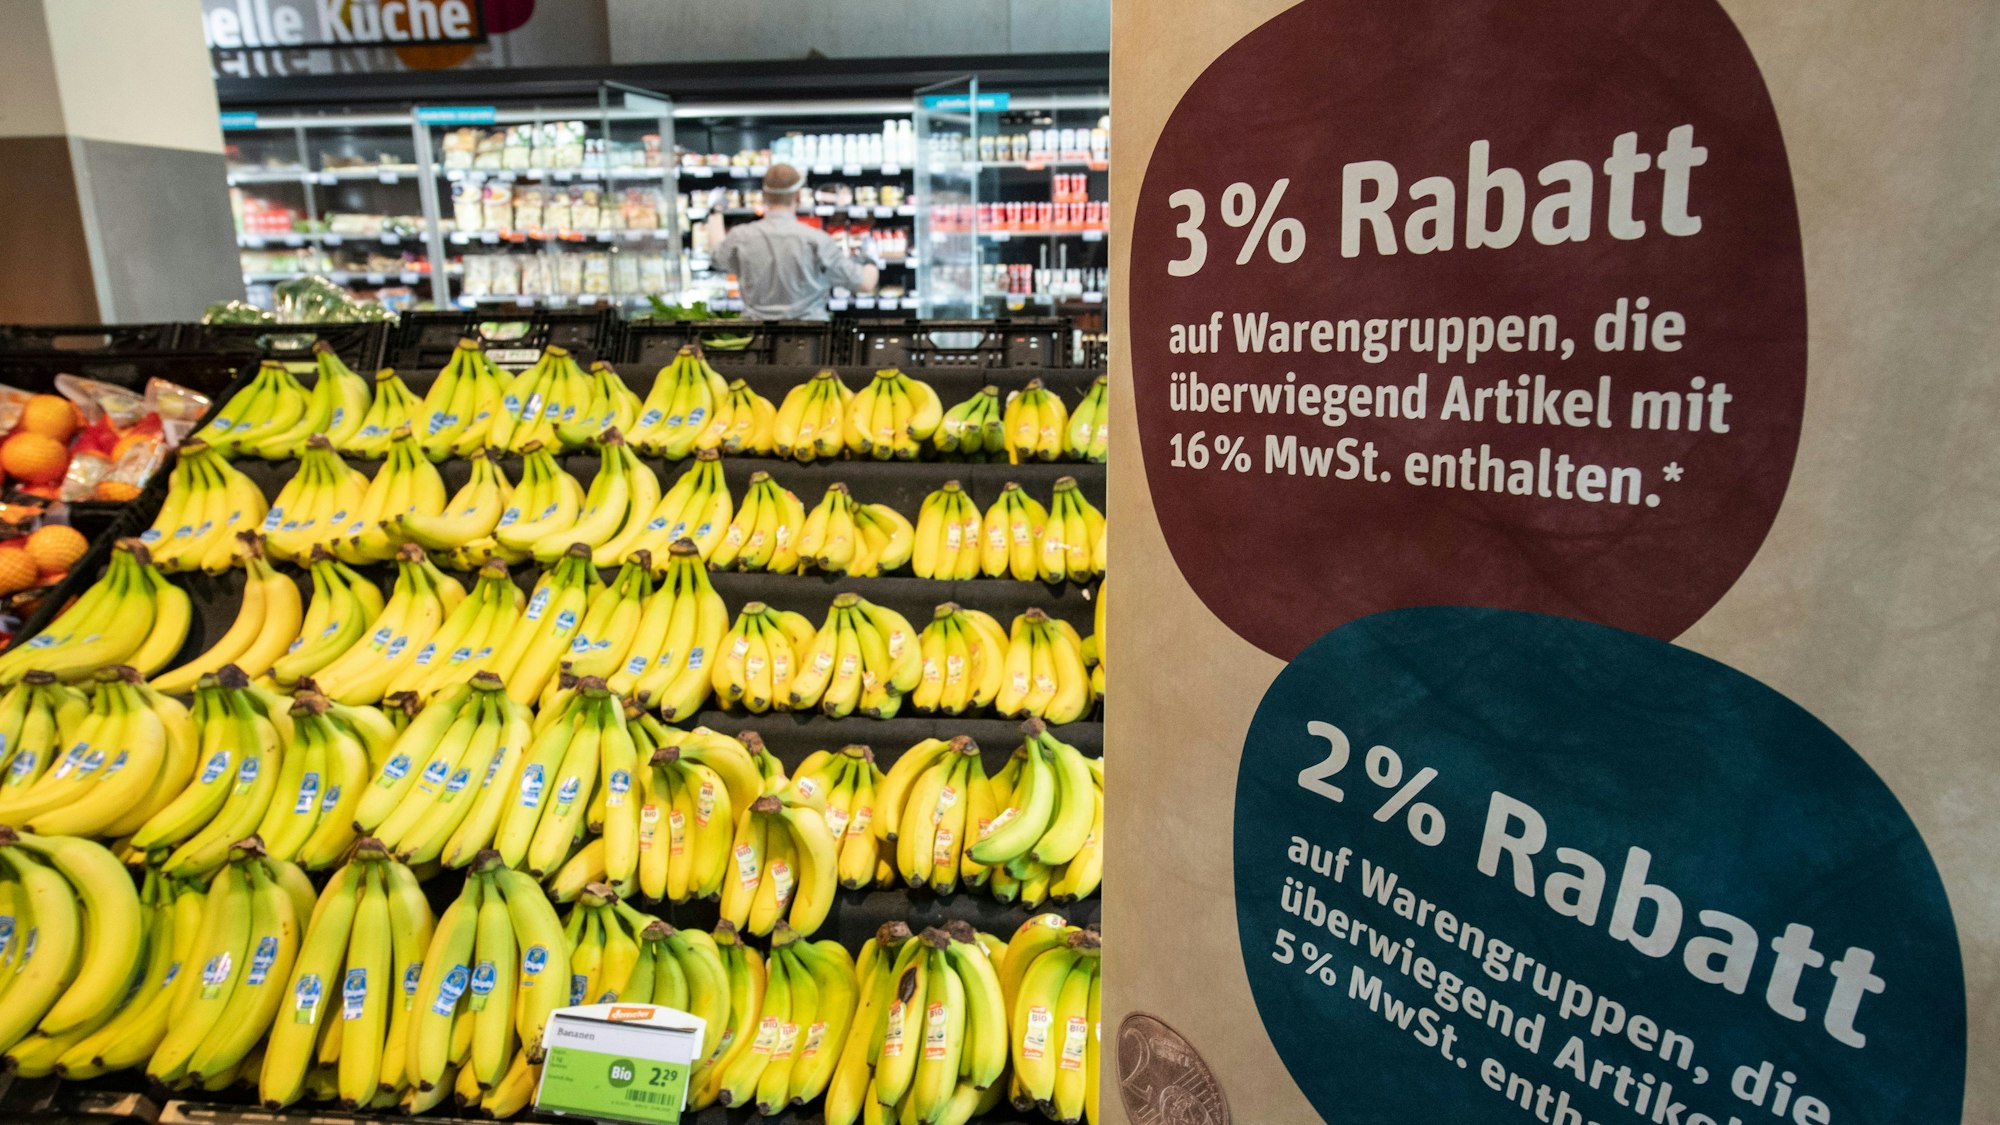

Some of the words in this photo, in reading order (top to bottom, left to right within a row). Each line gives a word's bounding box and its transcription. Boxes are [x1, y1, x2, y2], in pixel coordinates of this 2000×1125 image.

[203, 0, 303, 48] elle
[1341, 124, 1708, 259] Rabatt
[1169, 311, 1224, 354] auf
[1233, 312, 1575, 364] Warengruppen,
[1595, 297, 1686, 352] die
[1169, 371, 1428, 427] überwiegend
[1440, 375, 1612, 429] Artikel
[1631, 376, 1733, 434] mit
[1265, 435, 1392, 483] MwSt.
[1477, 791, 1886, 1049] Rabatt
[1280, 876, 1546, 1055] überwiegend
[1553, 1036, 1743, 1125] Artik
[1288, 835, 1353, 883] auf
[1362, 858, 1709, 1085] Warengruppen,
[1731, 1060, 1831, 1125] die
[556, 1027, 595, 1041] Bananen
[1031, 1014, 1048, 1023] BIO
[1069, 1023, 1086, 1033] BIO
[1349, 964, 1468, 1069] MwSt.
[1480, 1057, 1601, 1125] enth
[610, 1065, 633, 1081] Bio
